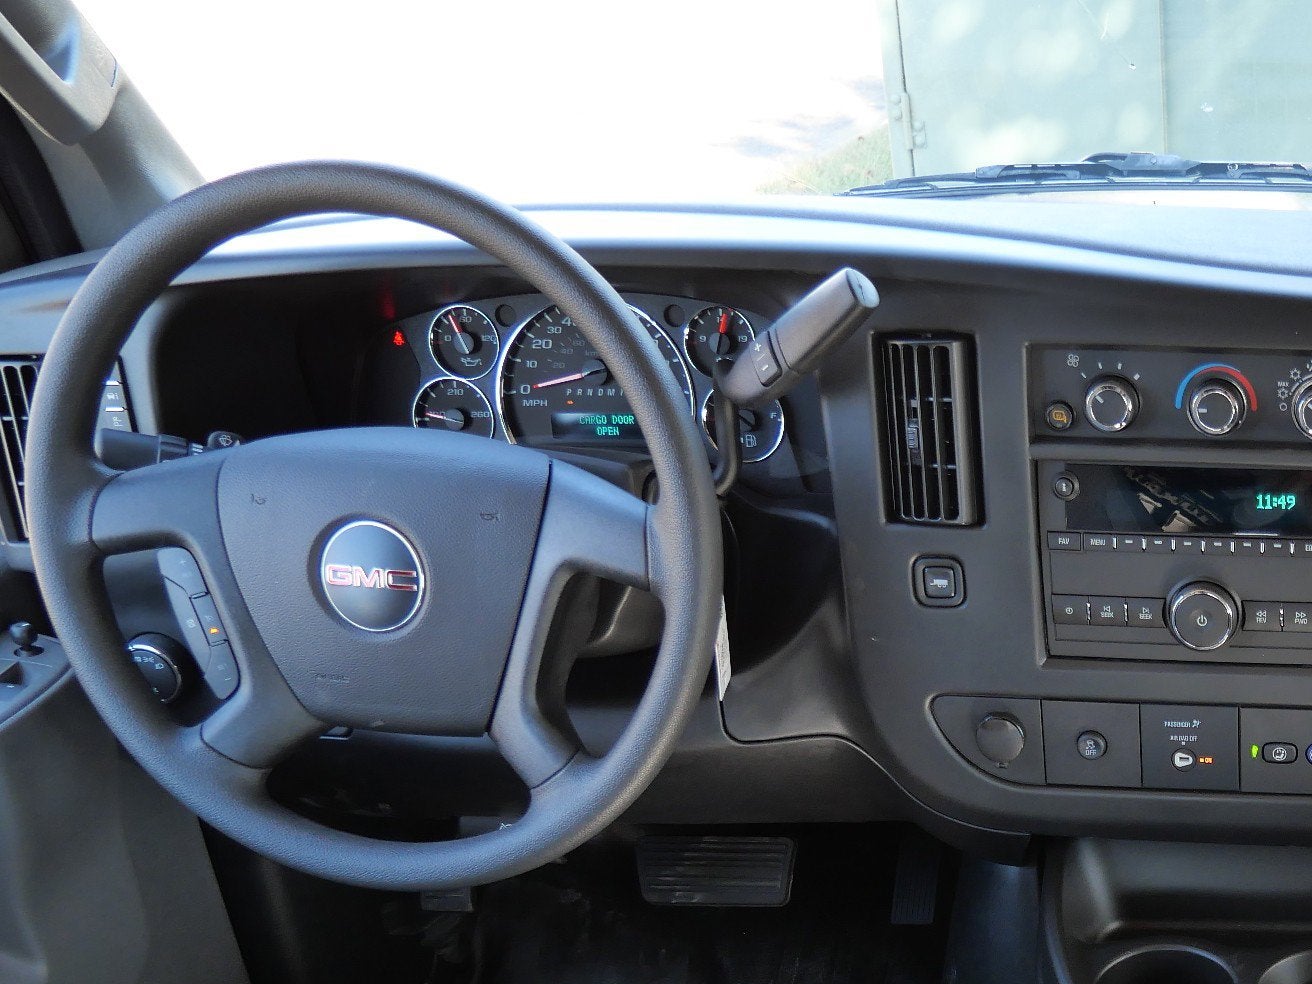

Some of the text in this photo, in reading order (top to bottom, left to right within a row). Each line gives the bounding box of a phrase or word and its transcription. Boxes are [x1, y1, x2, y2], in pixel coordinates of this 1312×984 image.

[532, 339, 553, 350] 20
[526, 361, 538, 369] 10
[521, 385, 531, 395] 0
[523, 399, 548, 407] MPH
[579, 415, 635, 425] CARGO DOOR
[596, 426, 620, 436] OPEN
[1256, 494, 1297, 510] 11:49
[1090, 538, 1106, 546] MENU
[325, 564, 418, 592] GMC
